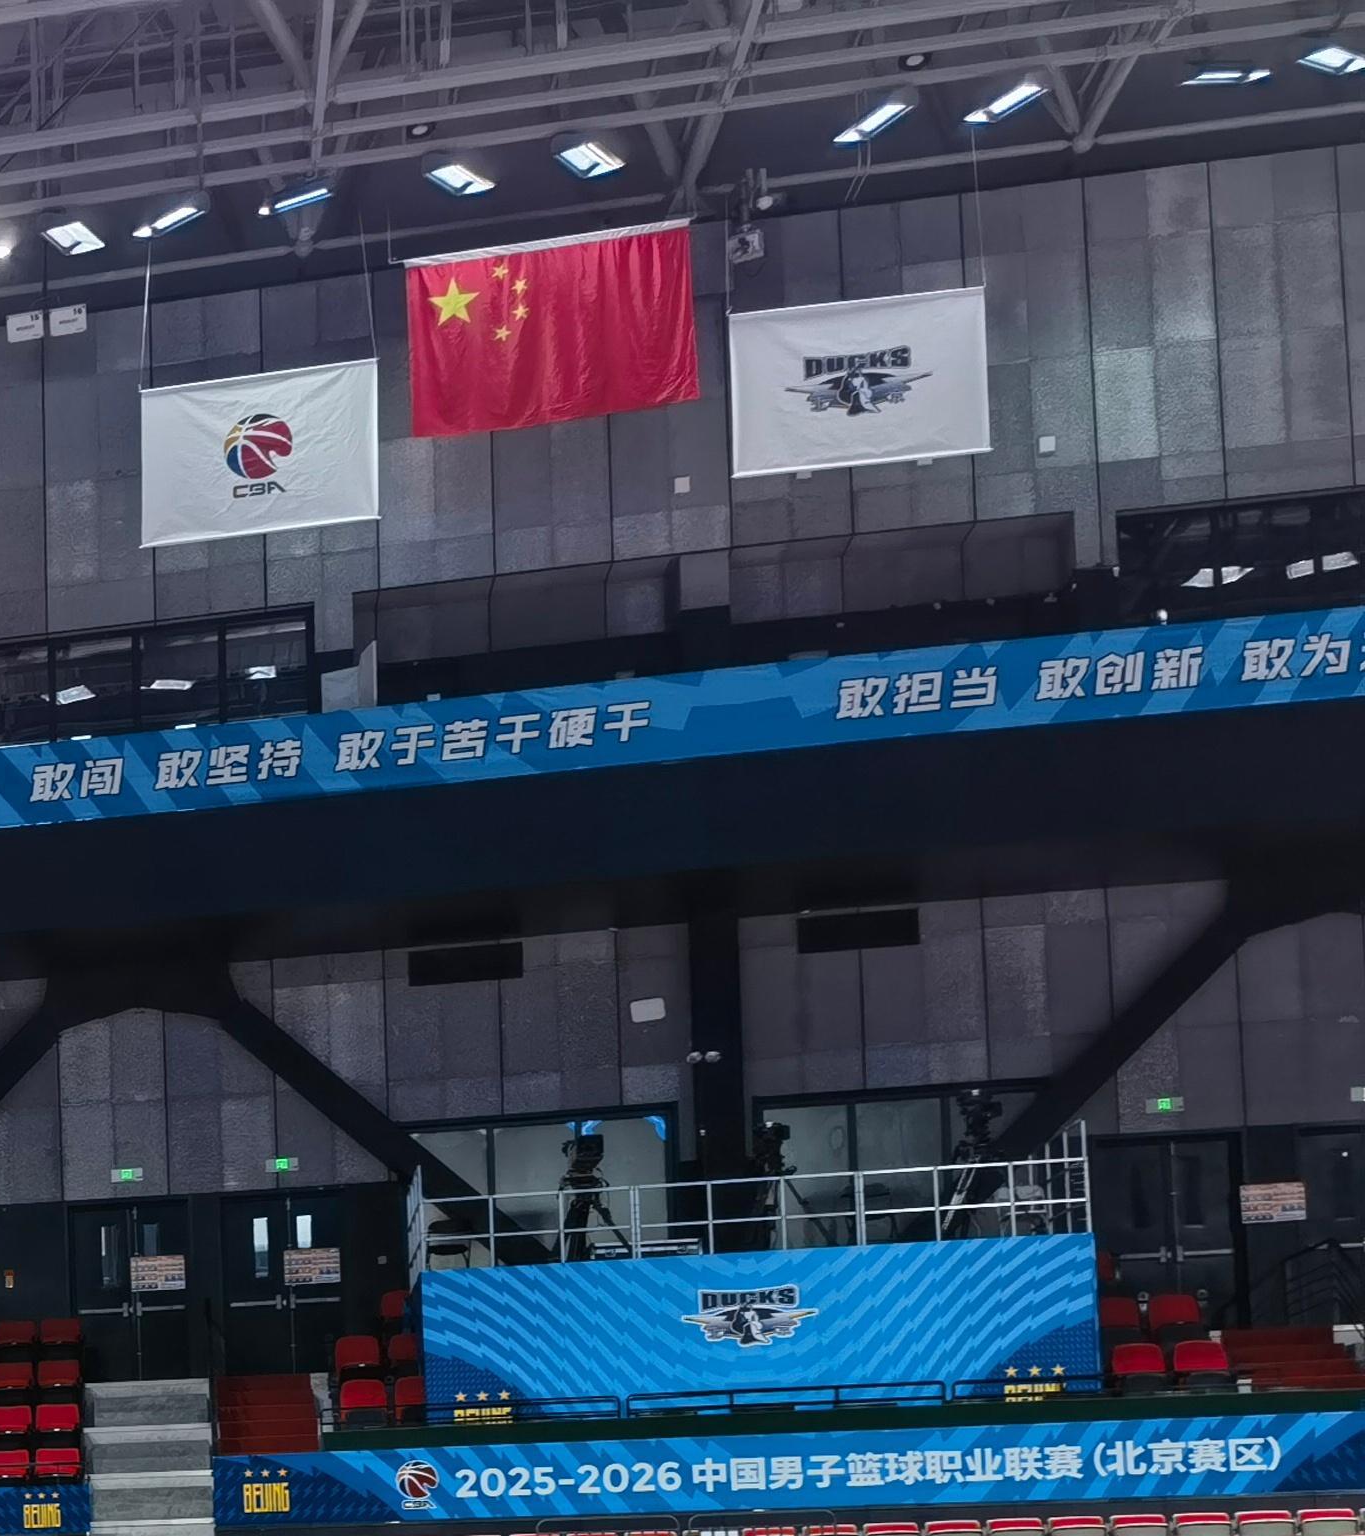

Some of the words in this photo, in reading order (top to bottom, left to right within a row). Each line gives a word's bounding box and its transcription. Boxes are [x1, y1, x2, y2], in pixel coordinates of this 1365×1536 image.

[802, 344, 911, 378] DUCKS
[232, 480, 285, 499] CBA
[30, 757, 124, 803] 敢闯
[155, 738, 303, 791] 敢坚持
[335, 700, 652, 772] 敢于苦干硬干
[837, 666, 999, 721] 敢担当
[1035, 645, 1204, 701] 敢创新
[1240, 631, 1365, 681] 敢为
[700, 1287, 796, 1311] DUCKS
[455, 1461, 680, 1498] 2025-2026
[243, 1482, 290, 1515] BEIJING
[23, 1503, 61, 1529] BEIJING
